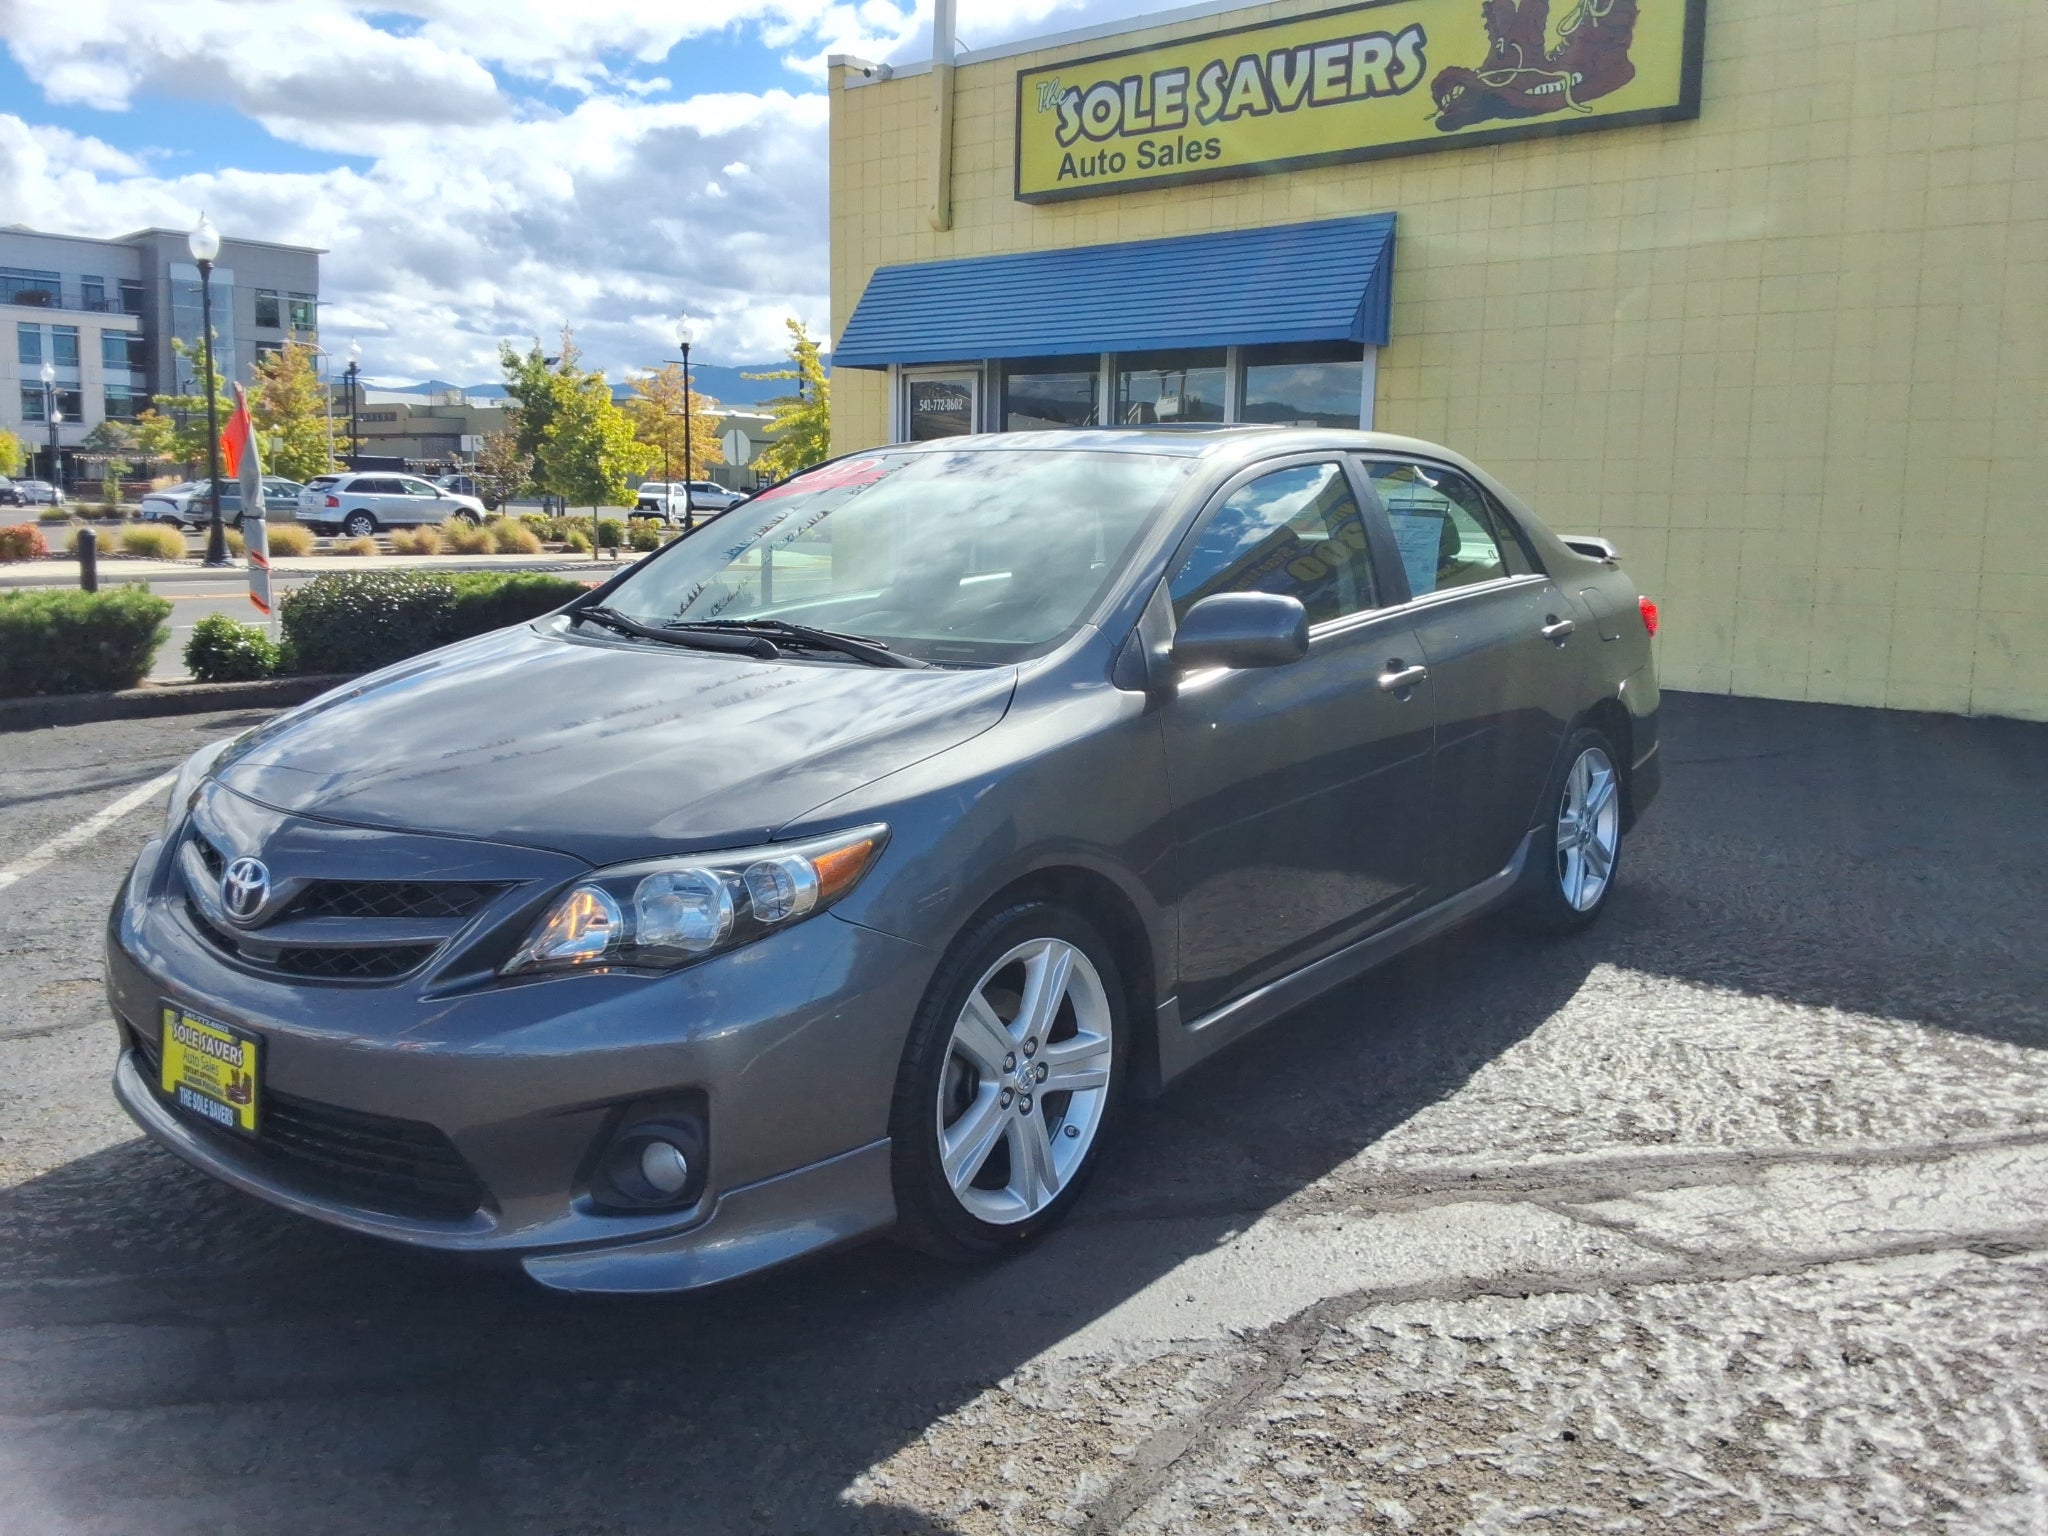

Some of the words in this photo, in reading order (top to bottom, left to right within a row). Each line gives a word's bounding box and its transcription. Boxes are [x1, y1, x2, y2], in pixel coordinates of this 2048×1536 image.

[1036, 77, 1069, 114] The
[1055, 66, 1190, 148] SOLE
[1195, 22, 1427, 126] SAVERS
[1057, 149, 1126, 181] Auto
[1136, 136, 1221, 170] Sales
[919, 398, 963, 411] 541-772-8602
[173, 1024, 200, 1051] SOLE
[201, 1033, 243, 1068] SAVERS
[183, 1048, 200, 1068] Auto
[201, 1055, 219, 1075] Sales
[180, 1086, 192, 1108] THE
[192, 1092, 209, 1116] SOLE
[209, 1099, 234, 1127] SAVERS
